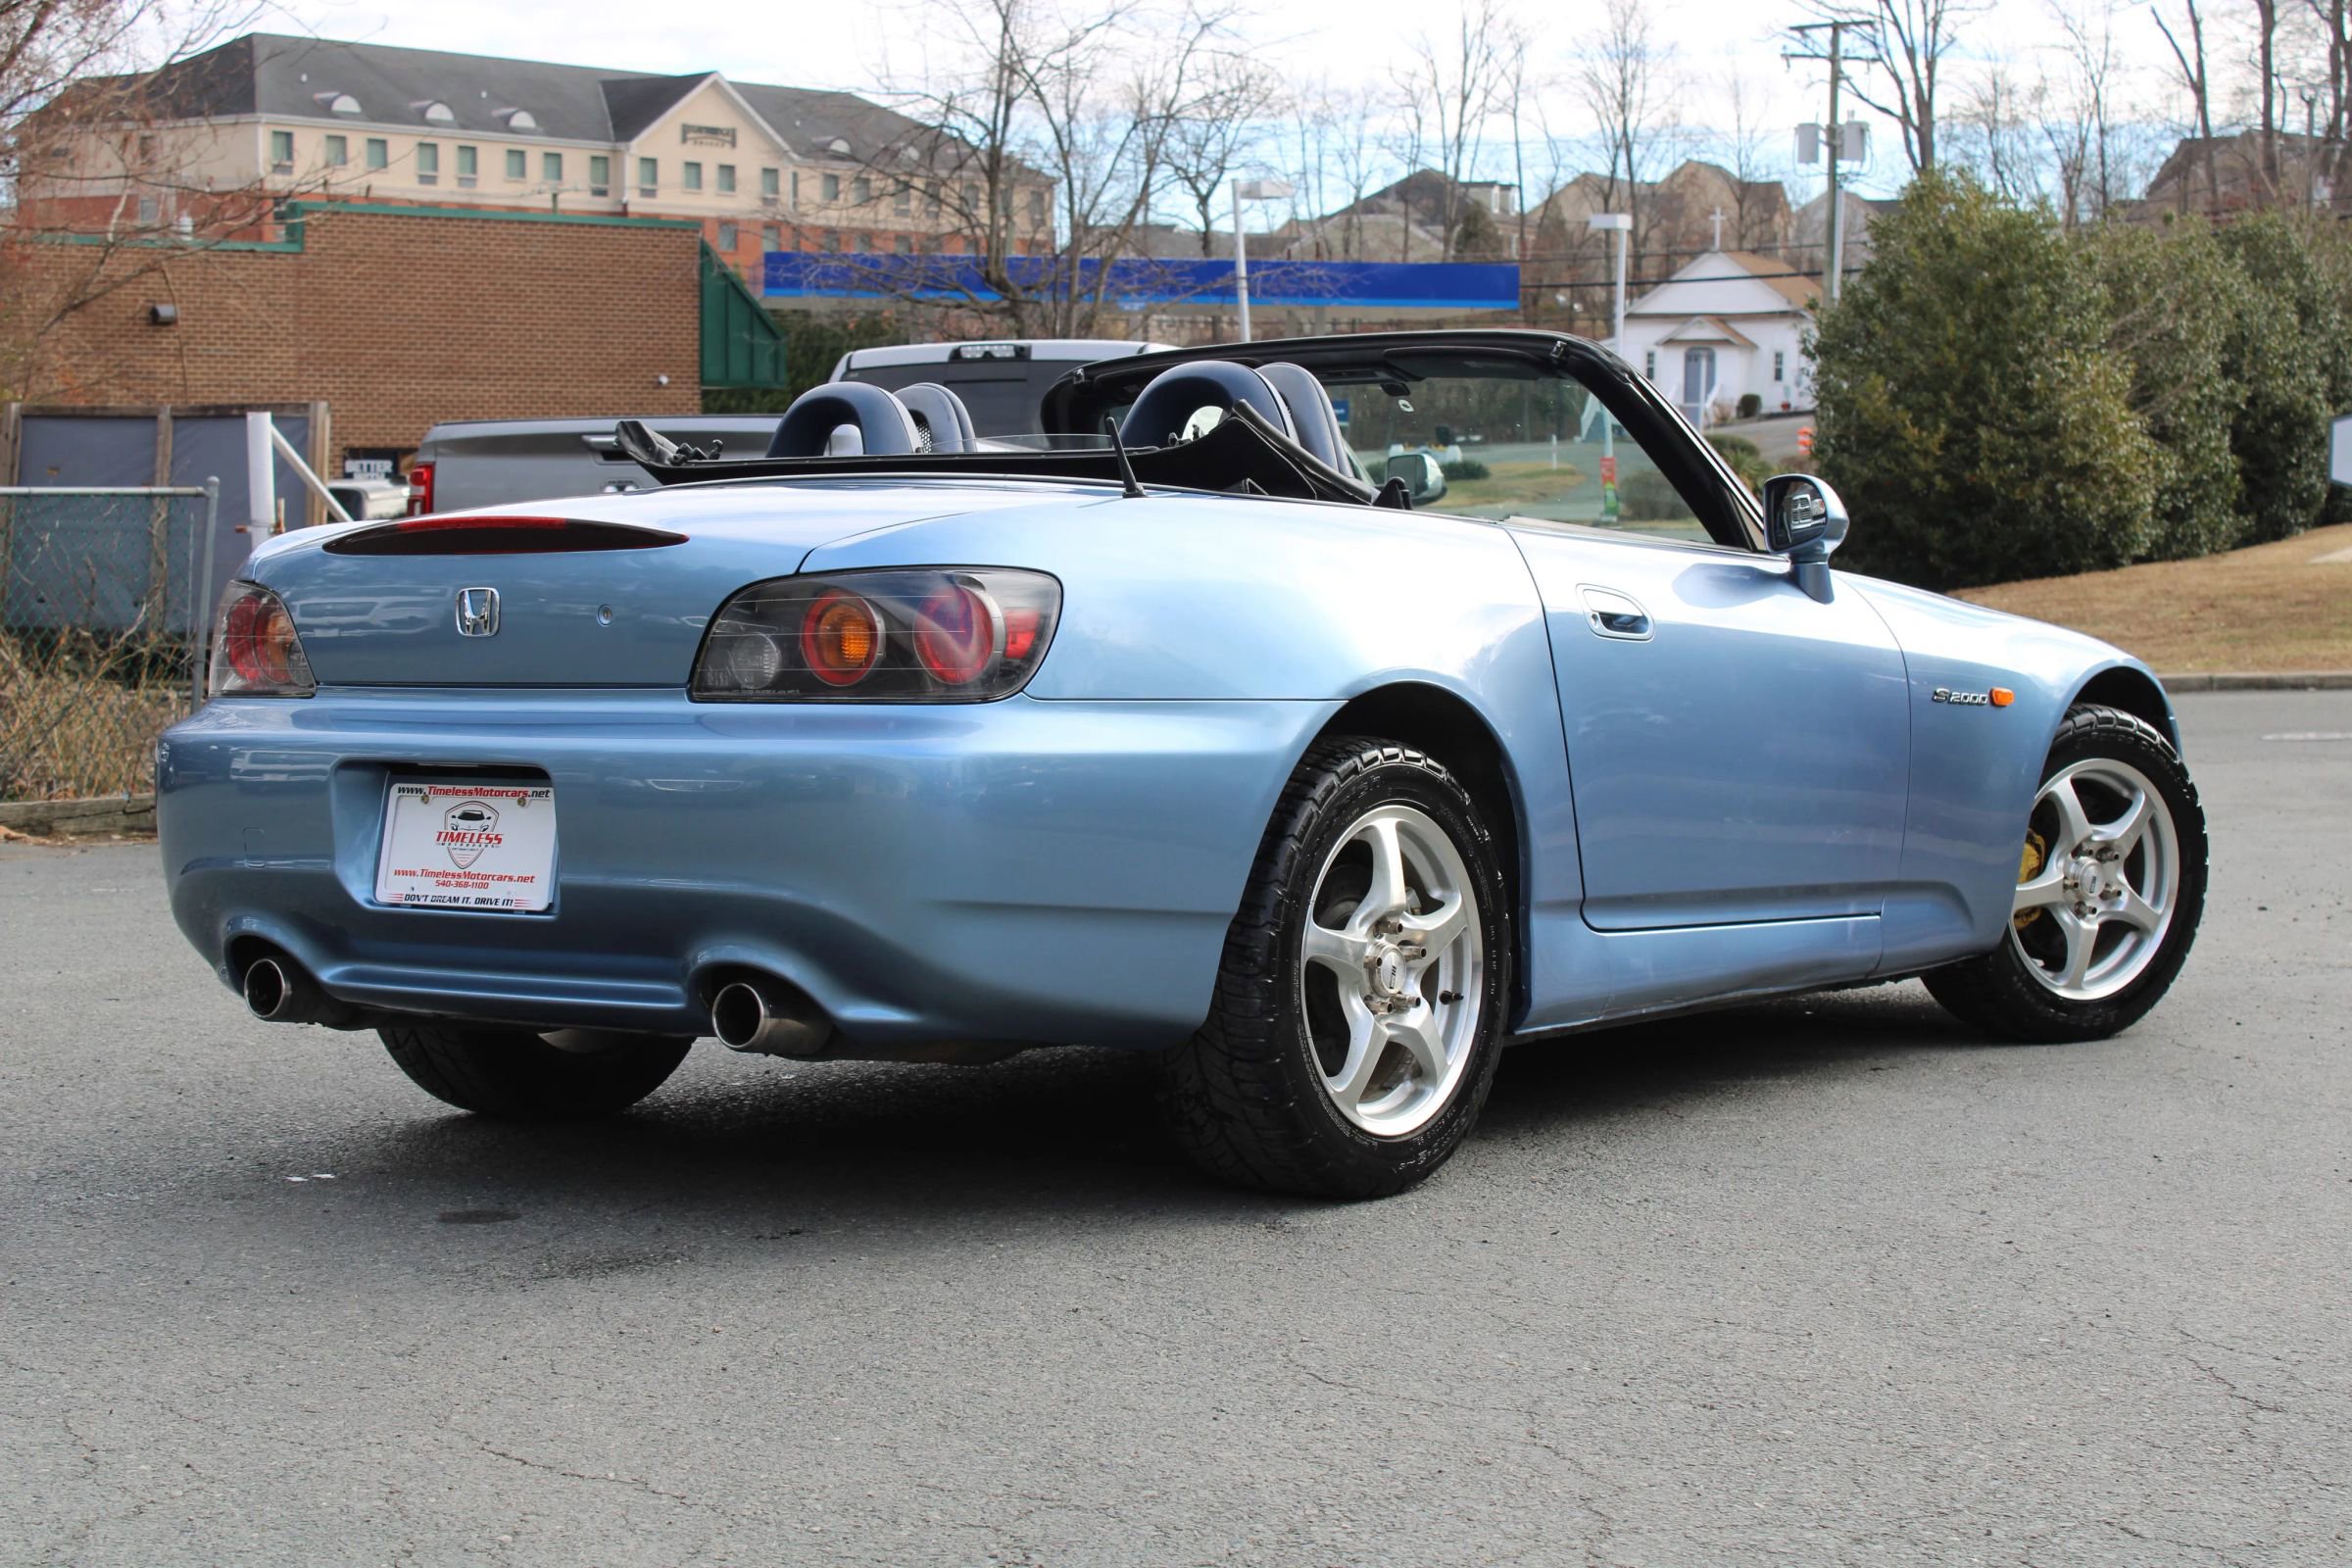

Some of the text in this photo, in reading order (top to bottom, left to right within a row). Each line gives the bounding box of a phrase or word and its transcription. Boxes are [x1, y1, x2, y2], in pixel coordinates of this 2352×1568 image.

[1933, 688, 1988, 705] S2000
[397, 786, 551, 799] www.TimelessMotorcars.net
[436, 831, 504, 845] TIMELESS
[394, 869, 535, 883] www.TimelessMotorcars.net
[435, 880, 489, 890] 540-368-1100
[404, 893, 428, 903] DON'T
[430, 895, 461, 905] DREAM
[474, 897, 500, 906] DRIVE
